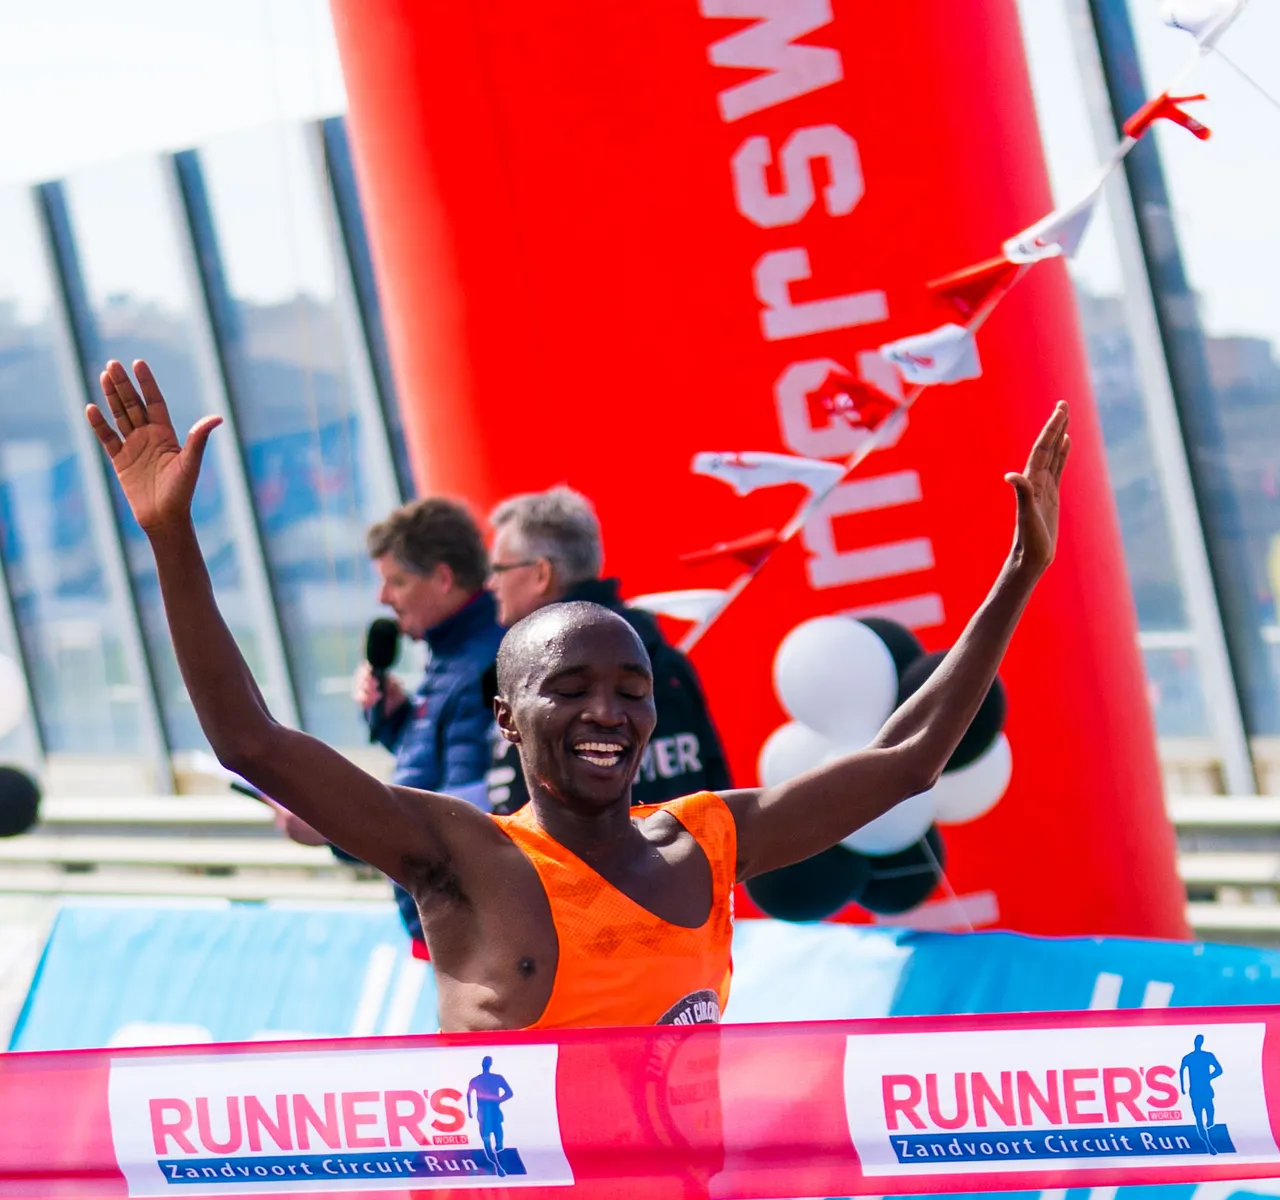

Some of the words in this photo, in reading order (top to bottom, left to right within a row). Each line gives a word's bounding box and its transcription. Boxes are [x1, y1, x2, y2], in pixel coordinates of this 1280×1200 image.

[881, 1065, 1180, 1130] RUNNER'S
[148, 1087, 466, 1155] RUNNER'S
[1150, 1111, 1181, 1120] WORLD
[434, 1135, 468, 1145] WORLD
[896, 1134, 1036, 1158] Zandvoort
[1044, 1132, 1134, 1154] Circuit
[1142, 1131, 1192, 1150] Run
[166, 1159, 312, 1180] Zandvoort
[323, 1156, 417, 1175] Circuit
[427, 1154, 479, 1172] Run
